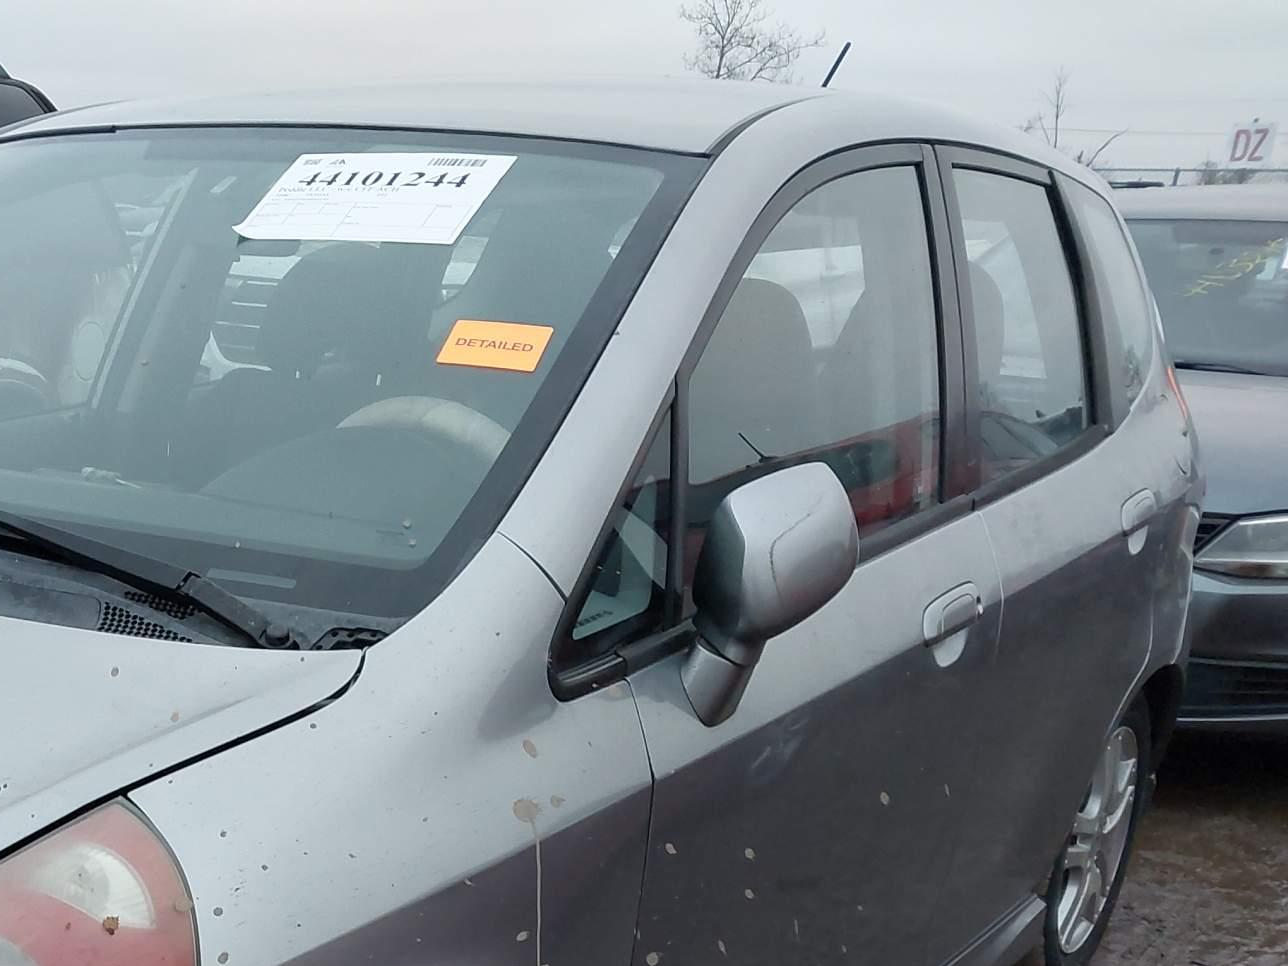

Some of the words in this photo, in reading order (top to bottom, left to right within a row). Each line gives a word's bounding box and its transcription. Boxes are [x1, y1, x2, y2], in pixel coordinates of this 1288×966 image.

[1230, 128, 1269, 161] DZ
[299, 171, 470, 188] 44101244
[455, 337, 534, 352] DETAILED
